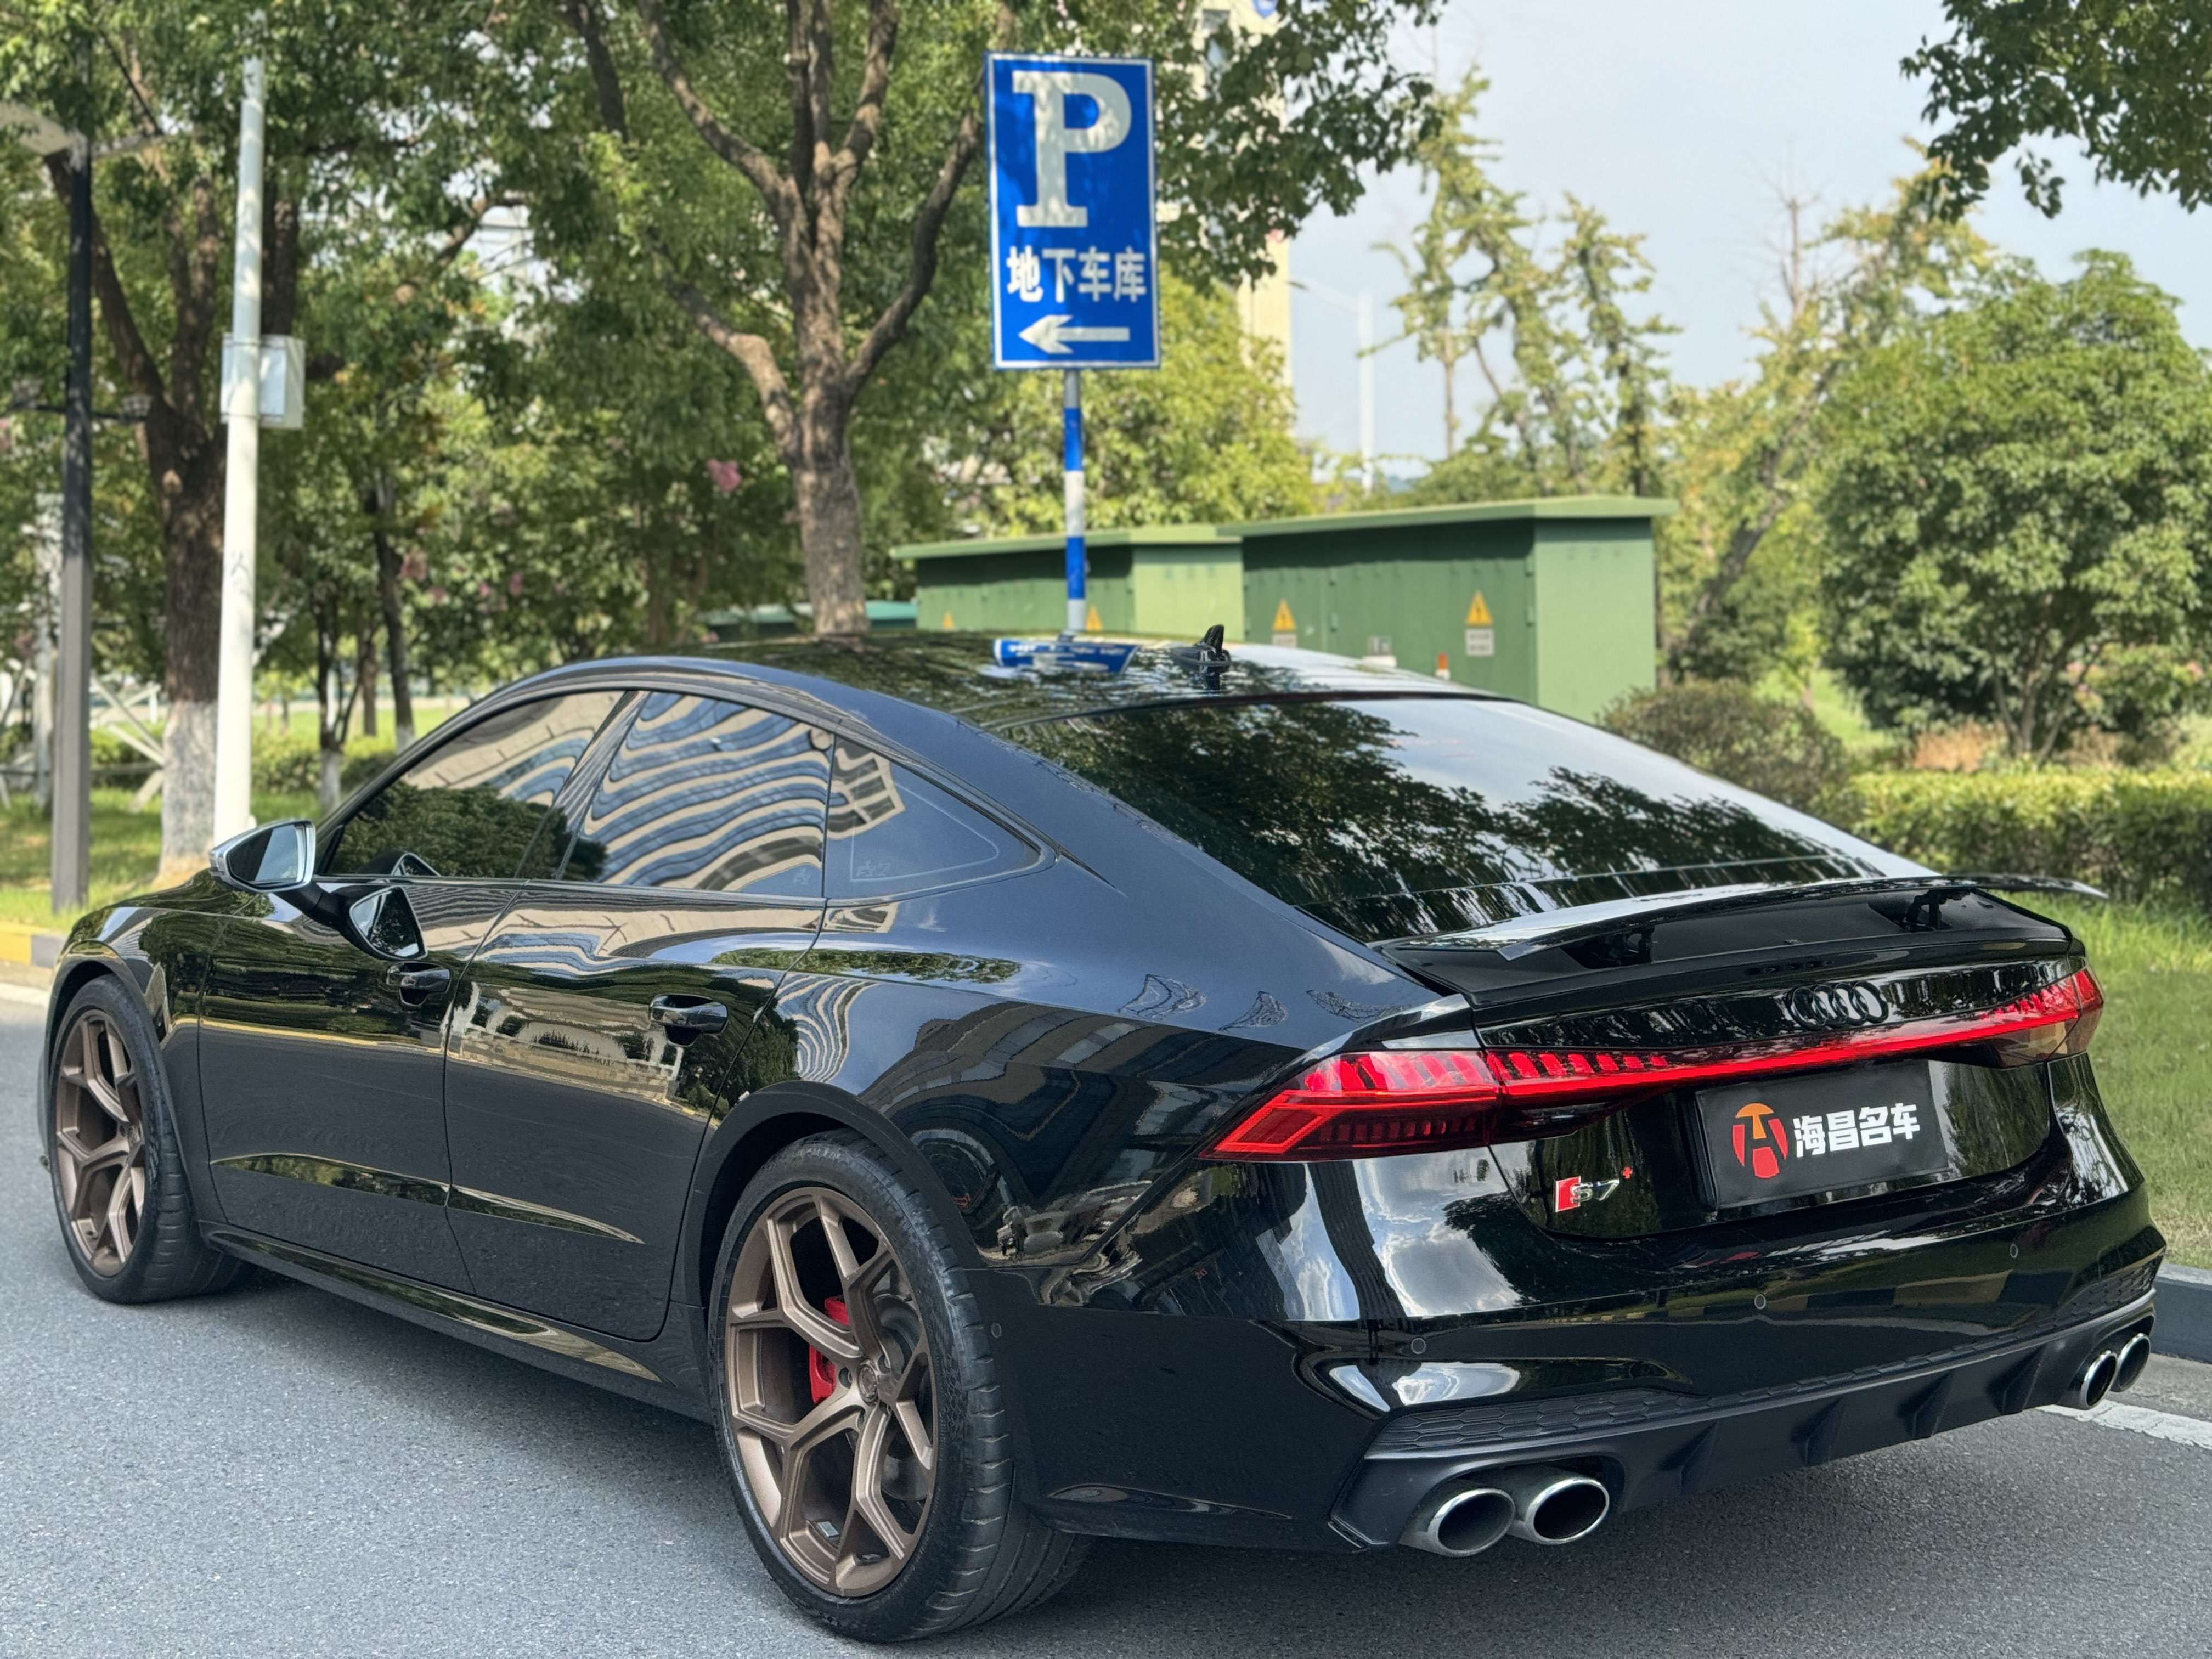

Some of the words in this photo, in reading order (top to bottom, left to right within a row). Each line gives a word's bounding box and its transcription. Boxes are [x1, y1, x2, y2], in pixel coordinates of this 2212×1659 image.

[1012, 70, 1132, 228] P
[1006, 245, 1147, 303] 地下车库
[1792, 1103, 1921, 1158] 海昌名车
